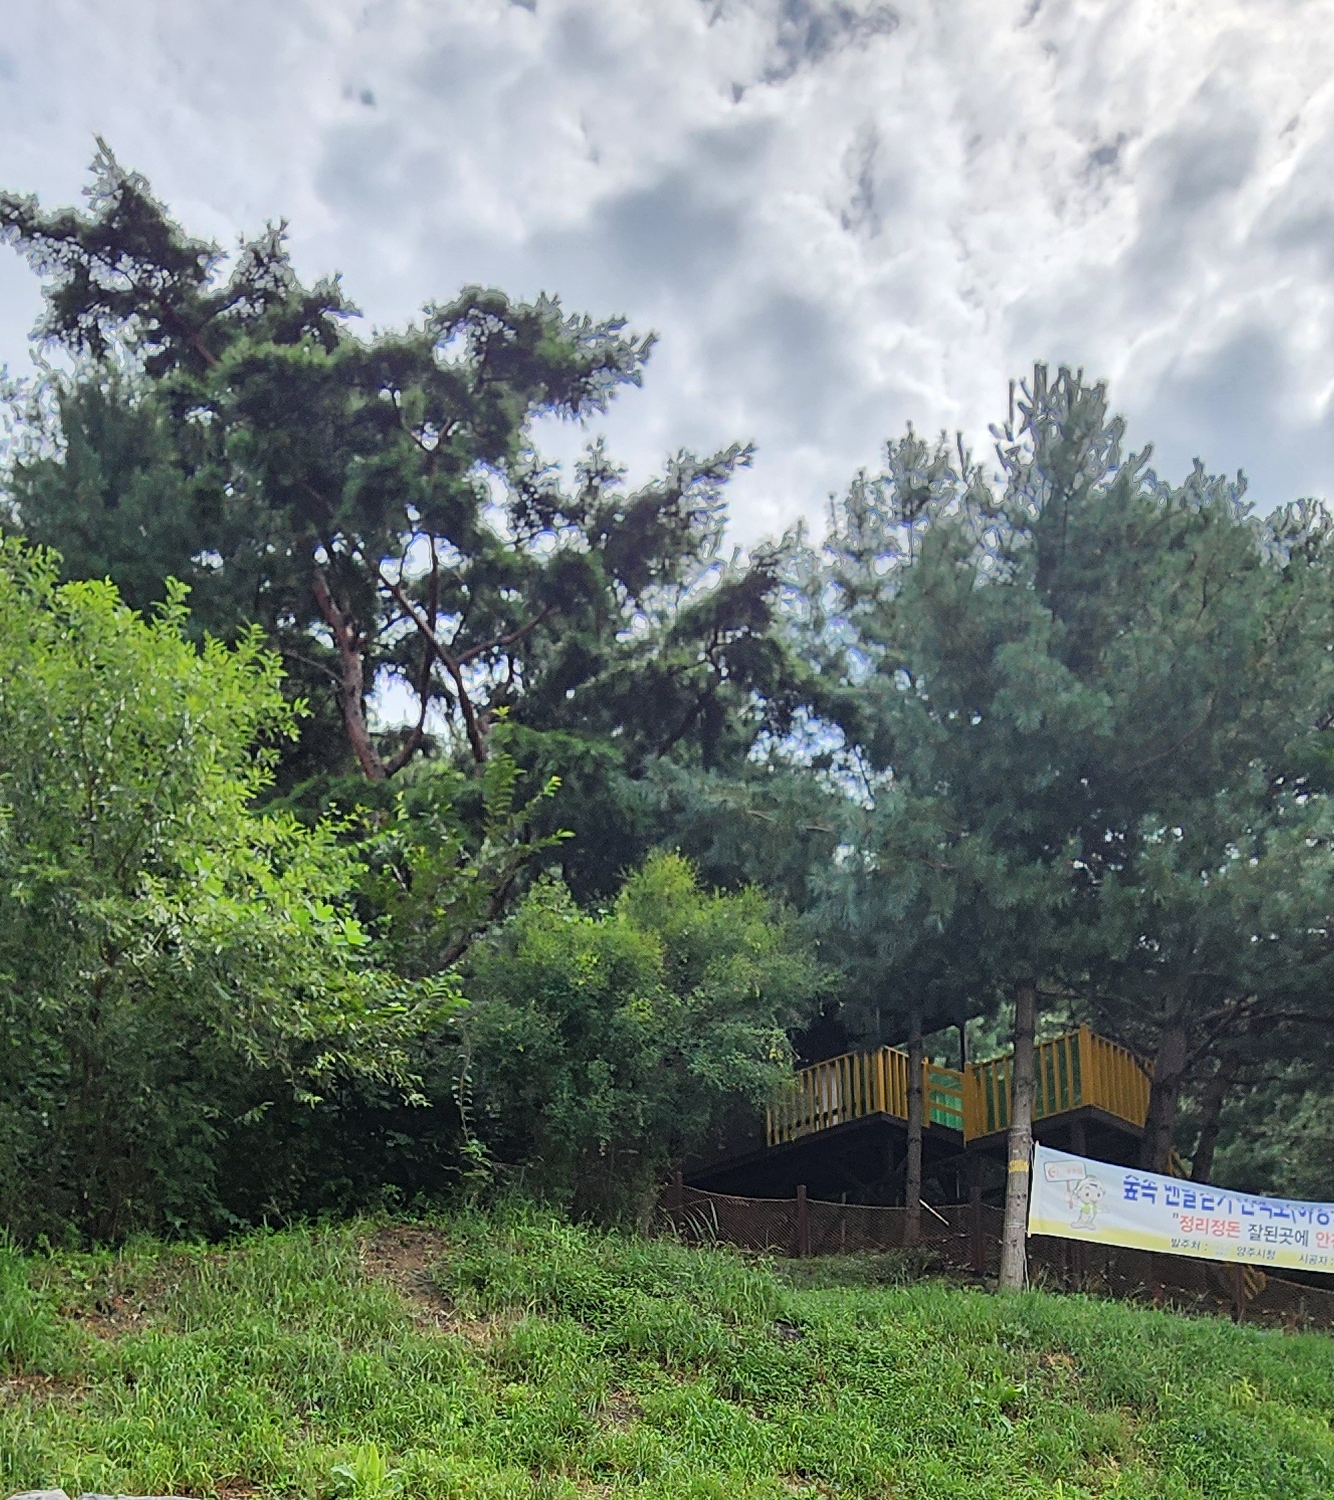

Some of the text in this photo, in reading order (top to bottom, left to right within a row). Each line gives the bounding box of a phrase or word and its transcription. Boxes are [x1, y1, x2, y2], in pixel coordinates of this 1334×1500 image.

[1123, 1174, 1158, 1204] 숲속
[1247, 1223, 1309, 1247] 잘된곳에
[1236, 1246, 1277, 1260] 양주시청
[1298, 1253, 1329, 1267] 시공자
